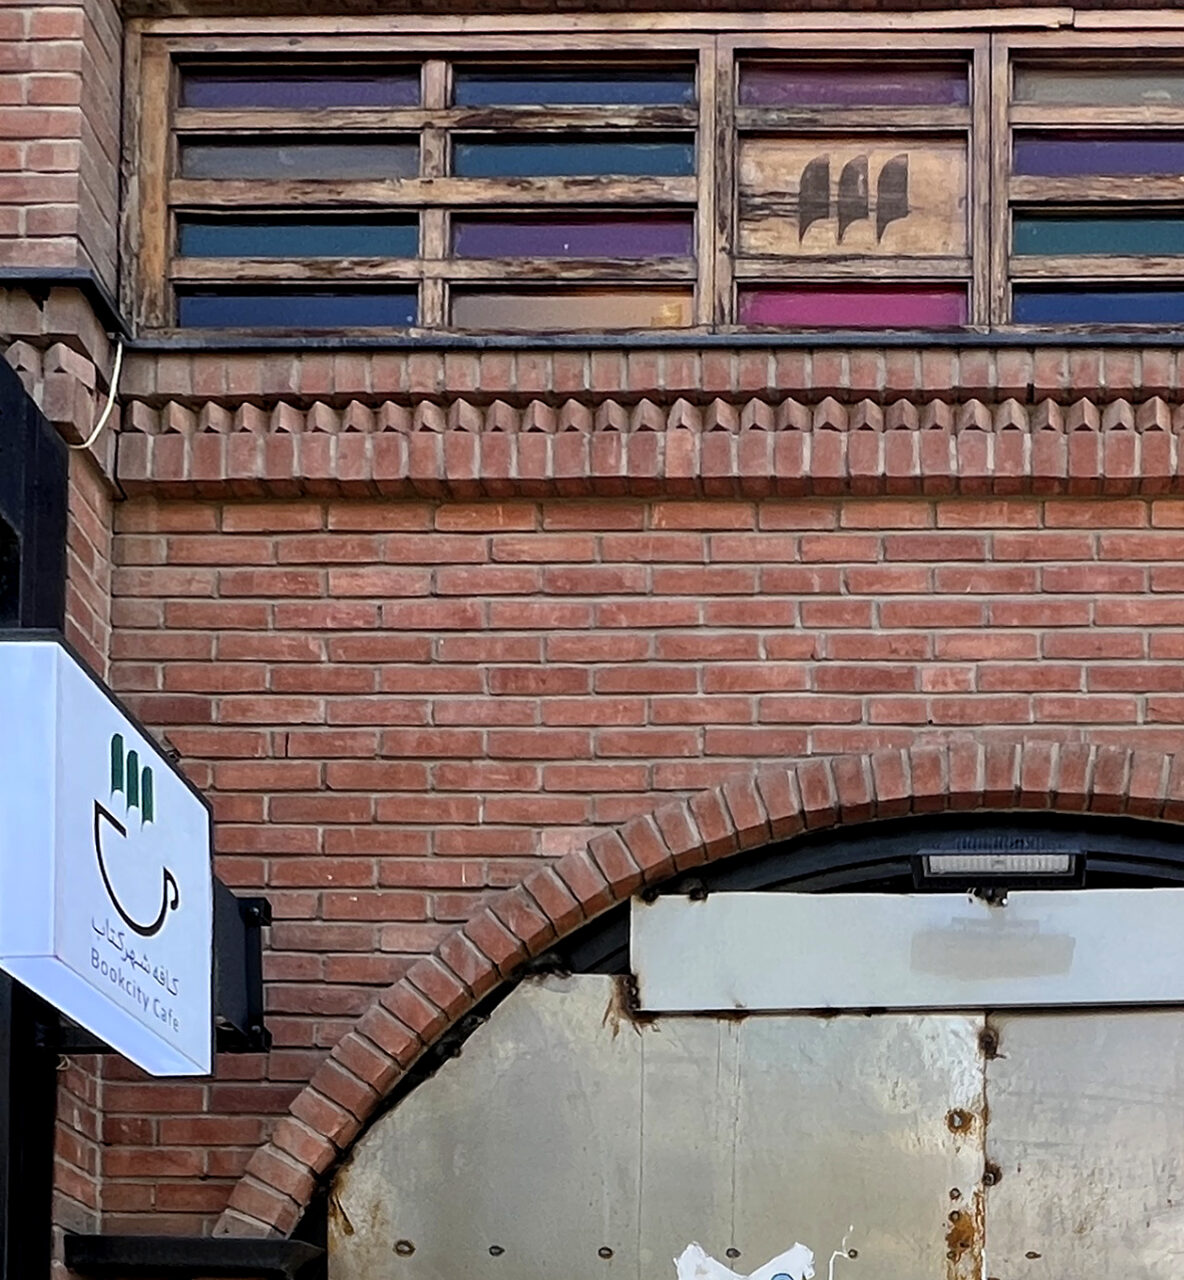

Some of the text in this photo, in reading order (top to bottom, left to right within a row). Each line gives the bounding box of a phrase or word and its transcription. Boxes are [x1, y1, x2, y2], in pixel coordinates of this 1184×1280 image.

[90, 947, 180, 1033] Bookcity Cafe
[91, 917, 180, 996] کافه شهر کتاب
